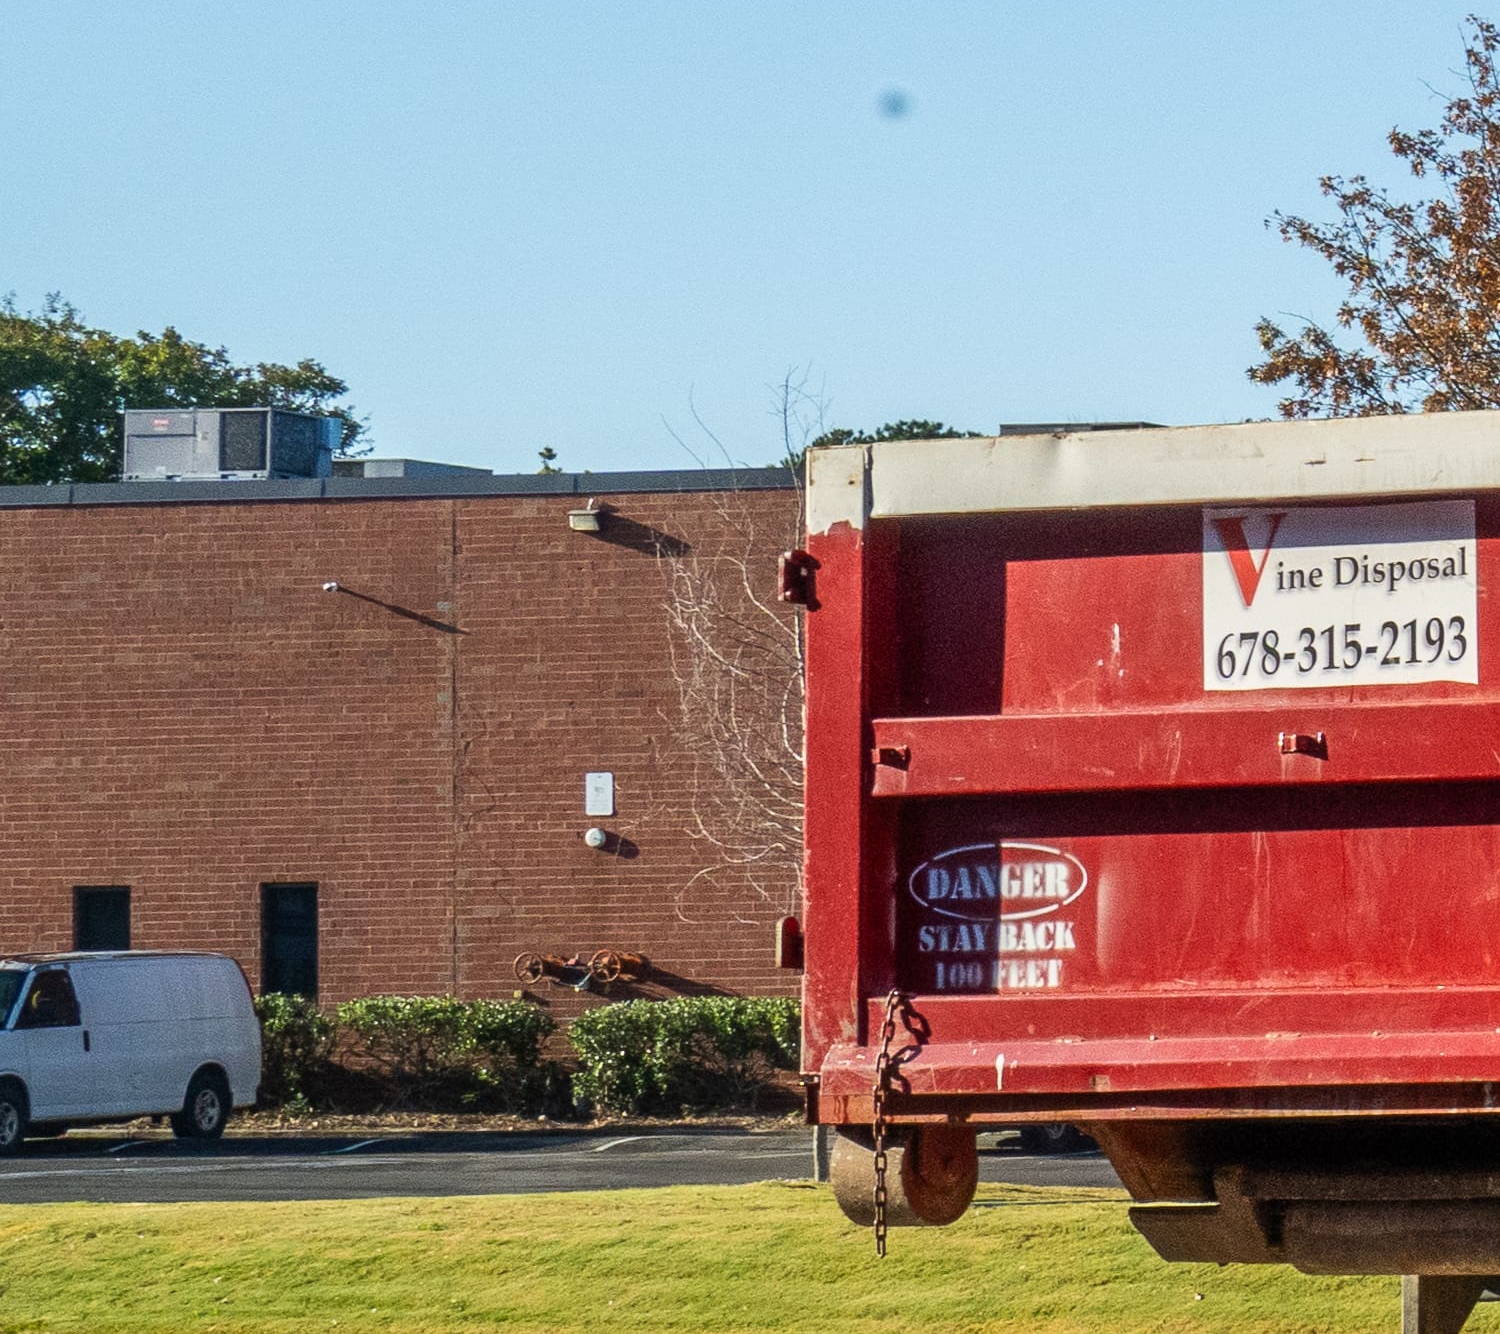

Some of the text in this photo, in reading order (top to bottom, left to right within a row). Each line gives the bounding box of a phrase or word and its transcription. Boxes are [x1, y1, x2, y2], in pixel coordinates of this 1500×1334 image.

[1213, 512, 1469, 608] Vine Disposal
[1216, 615, 1468, 679] 678-315-2193
[927, 861, 1071, 900] DANGER
[918, 920, 1077, 953] STAY BACK
[935, 958, 1064, 989] 100 FEET
